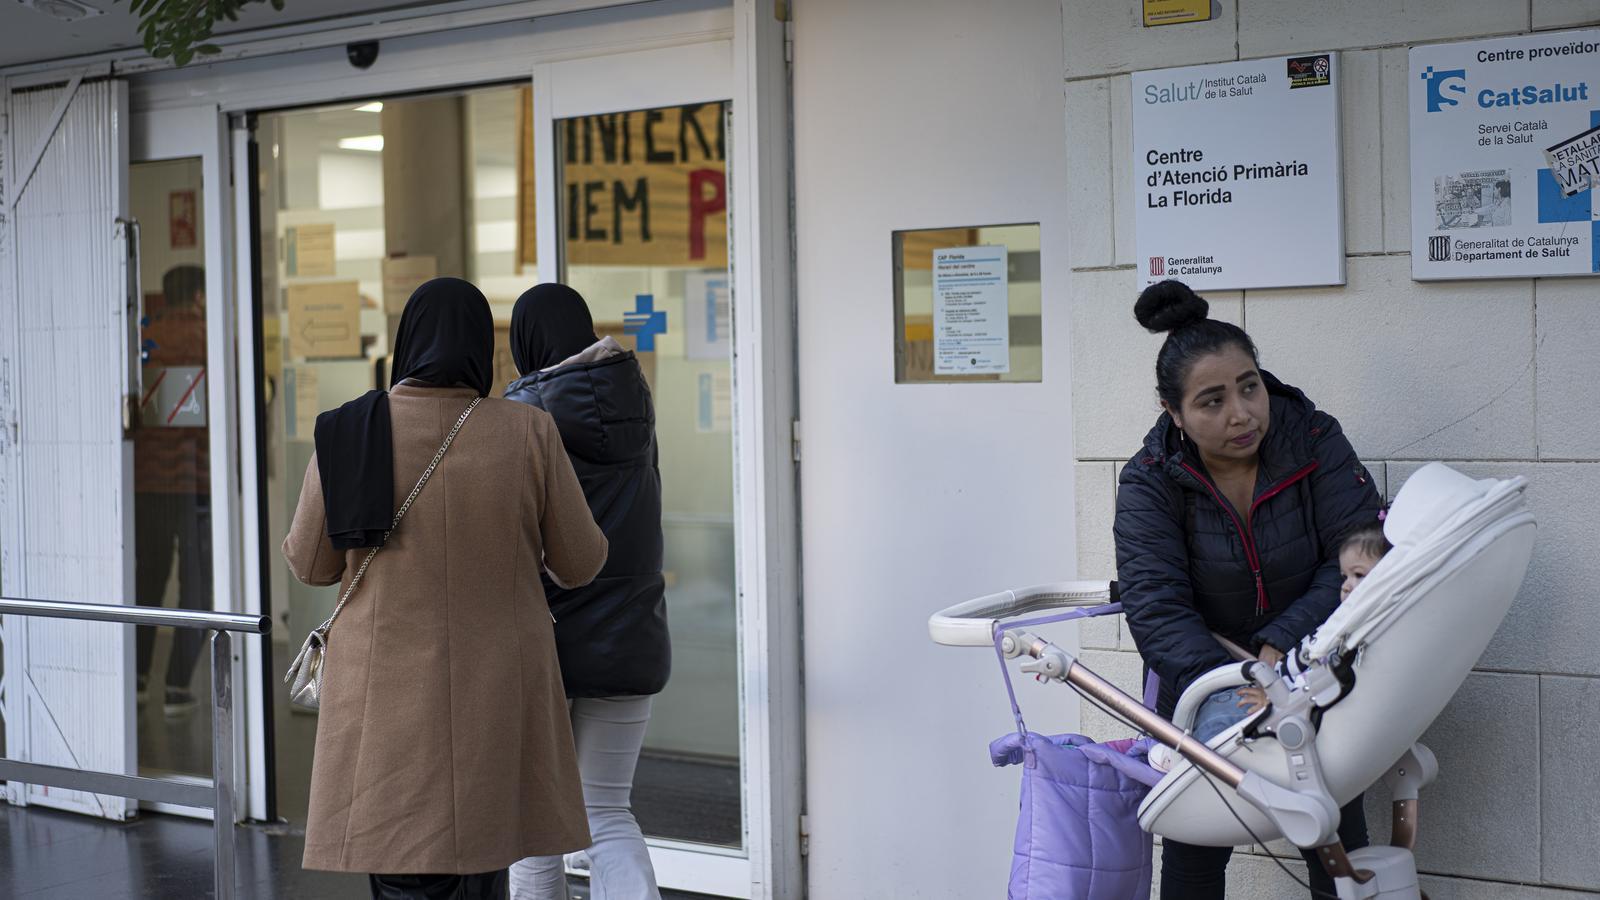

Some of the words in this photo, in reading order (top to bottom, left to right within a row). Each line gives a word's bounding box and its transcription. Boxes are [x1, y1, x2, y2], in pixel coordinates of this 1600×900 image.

[1477, 49, 1525, 63] Centre
[1529, 41, 1600, 61] proveïdor
[1205, 77, 1234, 88] Institut
[1237, 73, 1266, 85] Català
[1205, 89, 1216, 99] de
[1219, 88, 1227, 98] la
[1229, 86, 1253, 97] Salut
[1478, 82, 1588, 108] CatSalut
[1478, 122, 1511, 135] Servei
[1514, 119, 1548, 132] Català
[1478, 135, 1491, 146] de
[1494, 134, 1504, 146] la
[1506, 132, 1534, 145] Salut
[1146, 148, 1203, 166] Centre
[1233, 160, 1308, 181] Primària
[1148, 193, 1168, 208] La
[1173, 188, 1232, 207] Florida
[1454, 238, 1509, 250] Generalitat
[1511, 238, 1524, 248] de
[1527, 235, 1579, 249] Catalunya
[1168, 256, 1213, 266] Generalitat
[1455, 250, 1522, 263] Departament
[1525, 248, 1538, 258] de
[1541, 247, 1570, 257] Salut
[1168, 268, 1179, 276] de
[1180, 266, 1222, 276] Catalunya
